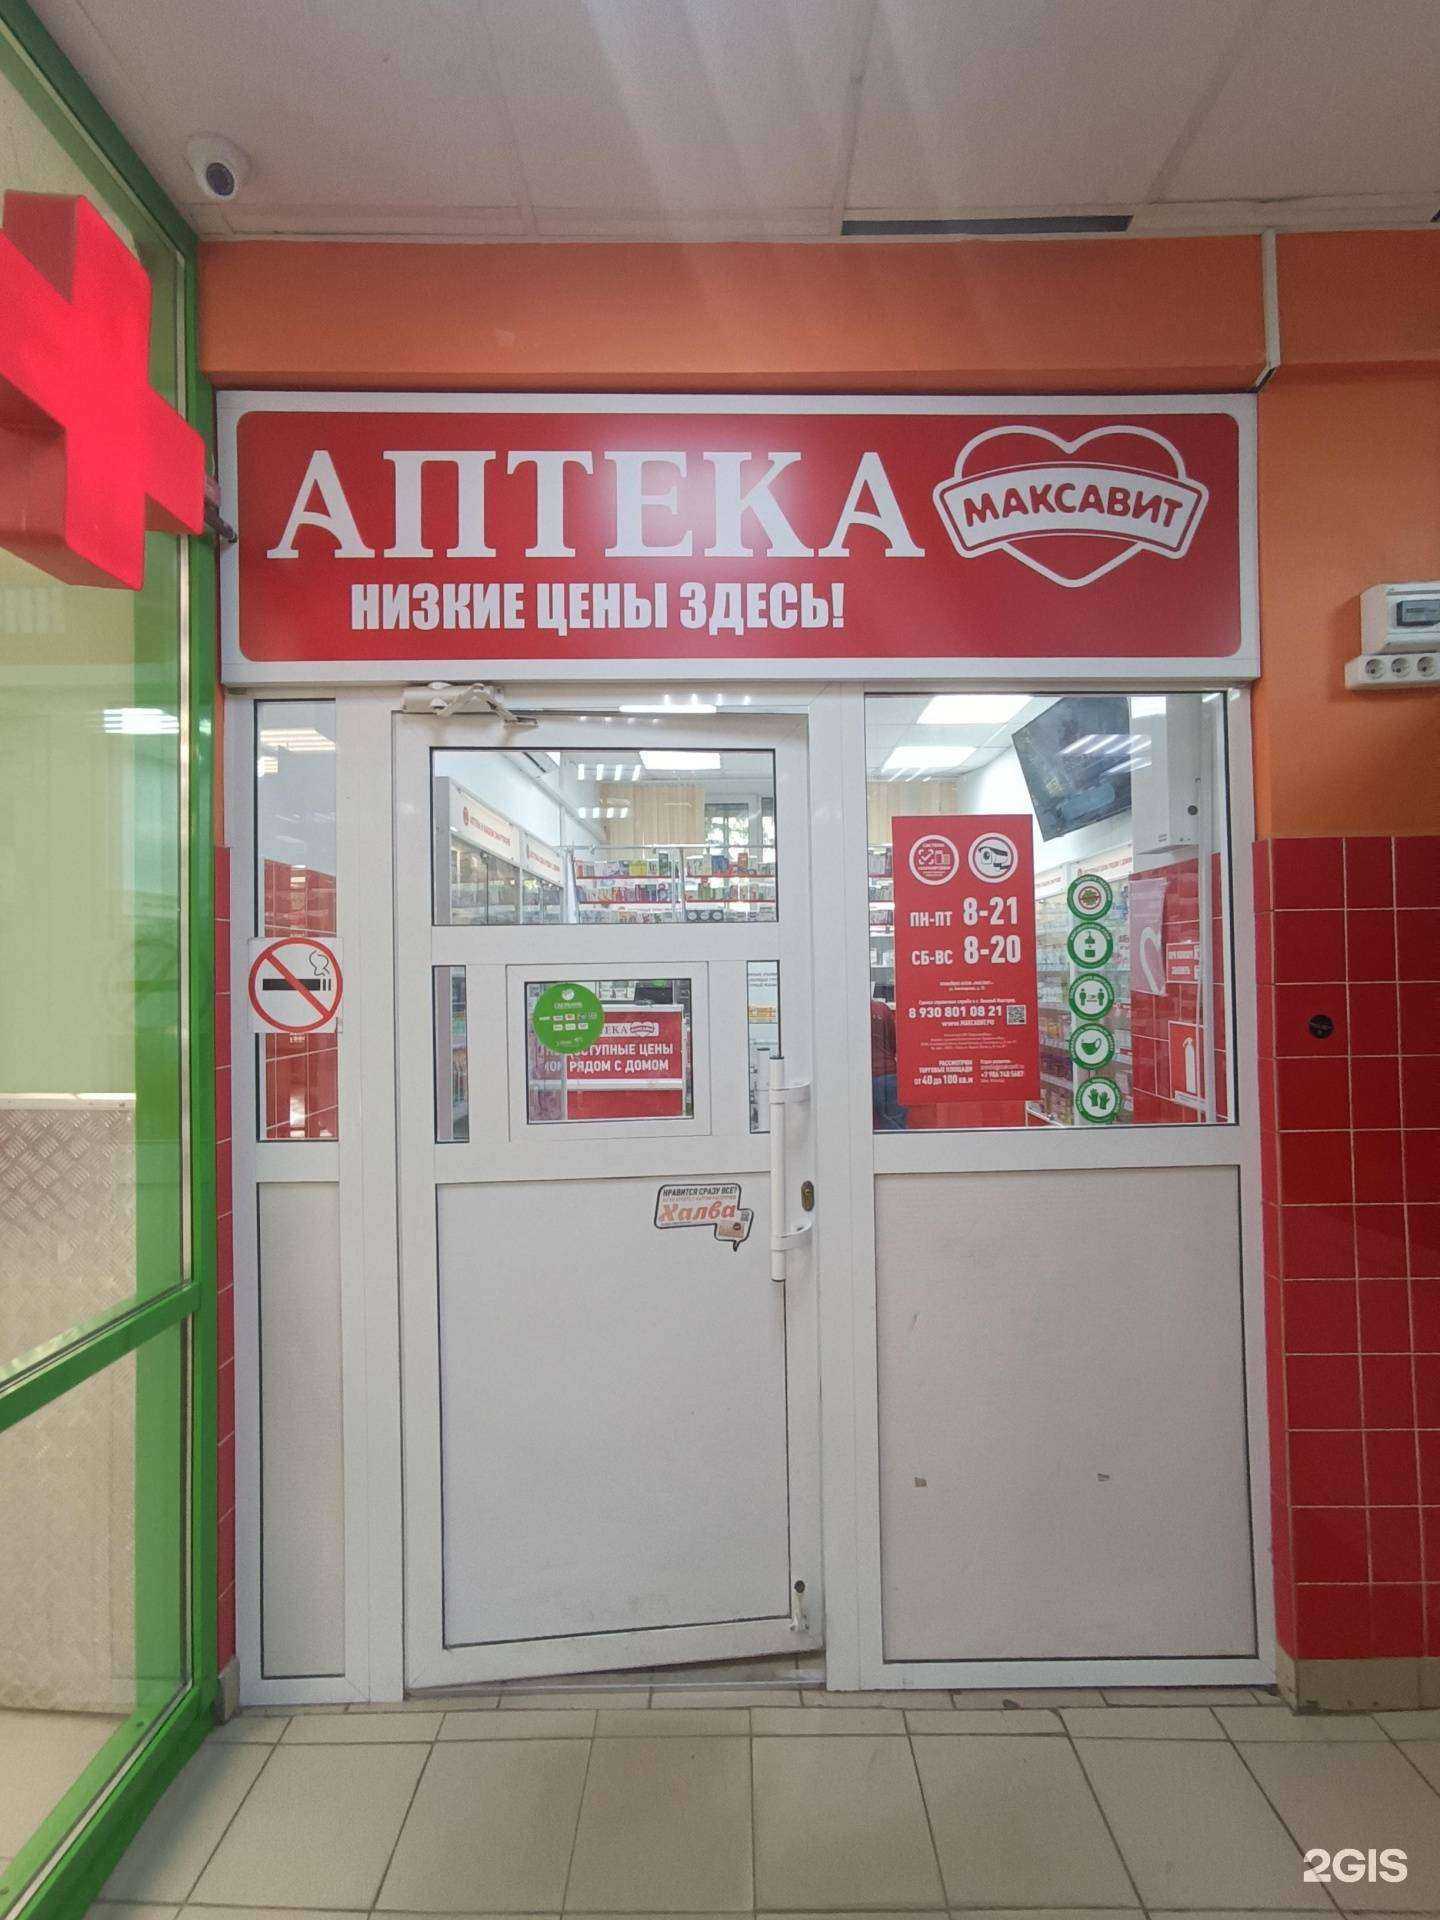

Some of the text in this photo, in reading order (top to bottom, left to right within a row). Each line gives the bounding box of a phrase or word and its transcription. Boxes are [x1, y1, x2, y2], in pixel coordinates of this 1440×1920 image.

[266, 449, 926, 560] АПТЕКА
[963, 482, 1183, 528] МАКСАВИТ
[350, 581, 845, 637] НИЗКИЕ ЦЕНЫ ЗДЕСЬ!
[909, 896, 1018, 927] ПН-ПТ 8-21
[911, 935, 1021, 966] СБ-ВС 8-20
[908, 1005, 1002, 1019] 8 930 801 08 21
[639, 1043, 674, 1058] ЦЕНЫ
[569, 1060, 611, 1074] РЯДОМ
[614, 1060, 622, 1072] С
[624, 1059, 670, 1074] ДОМОМ
[659, 1200, 737, 1222] Халва
